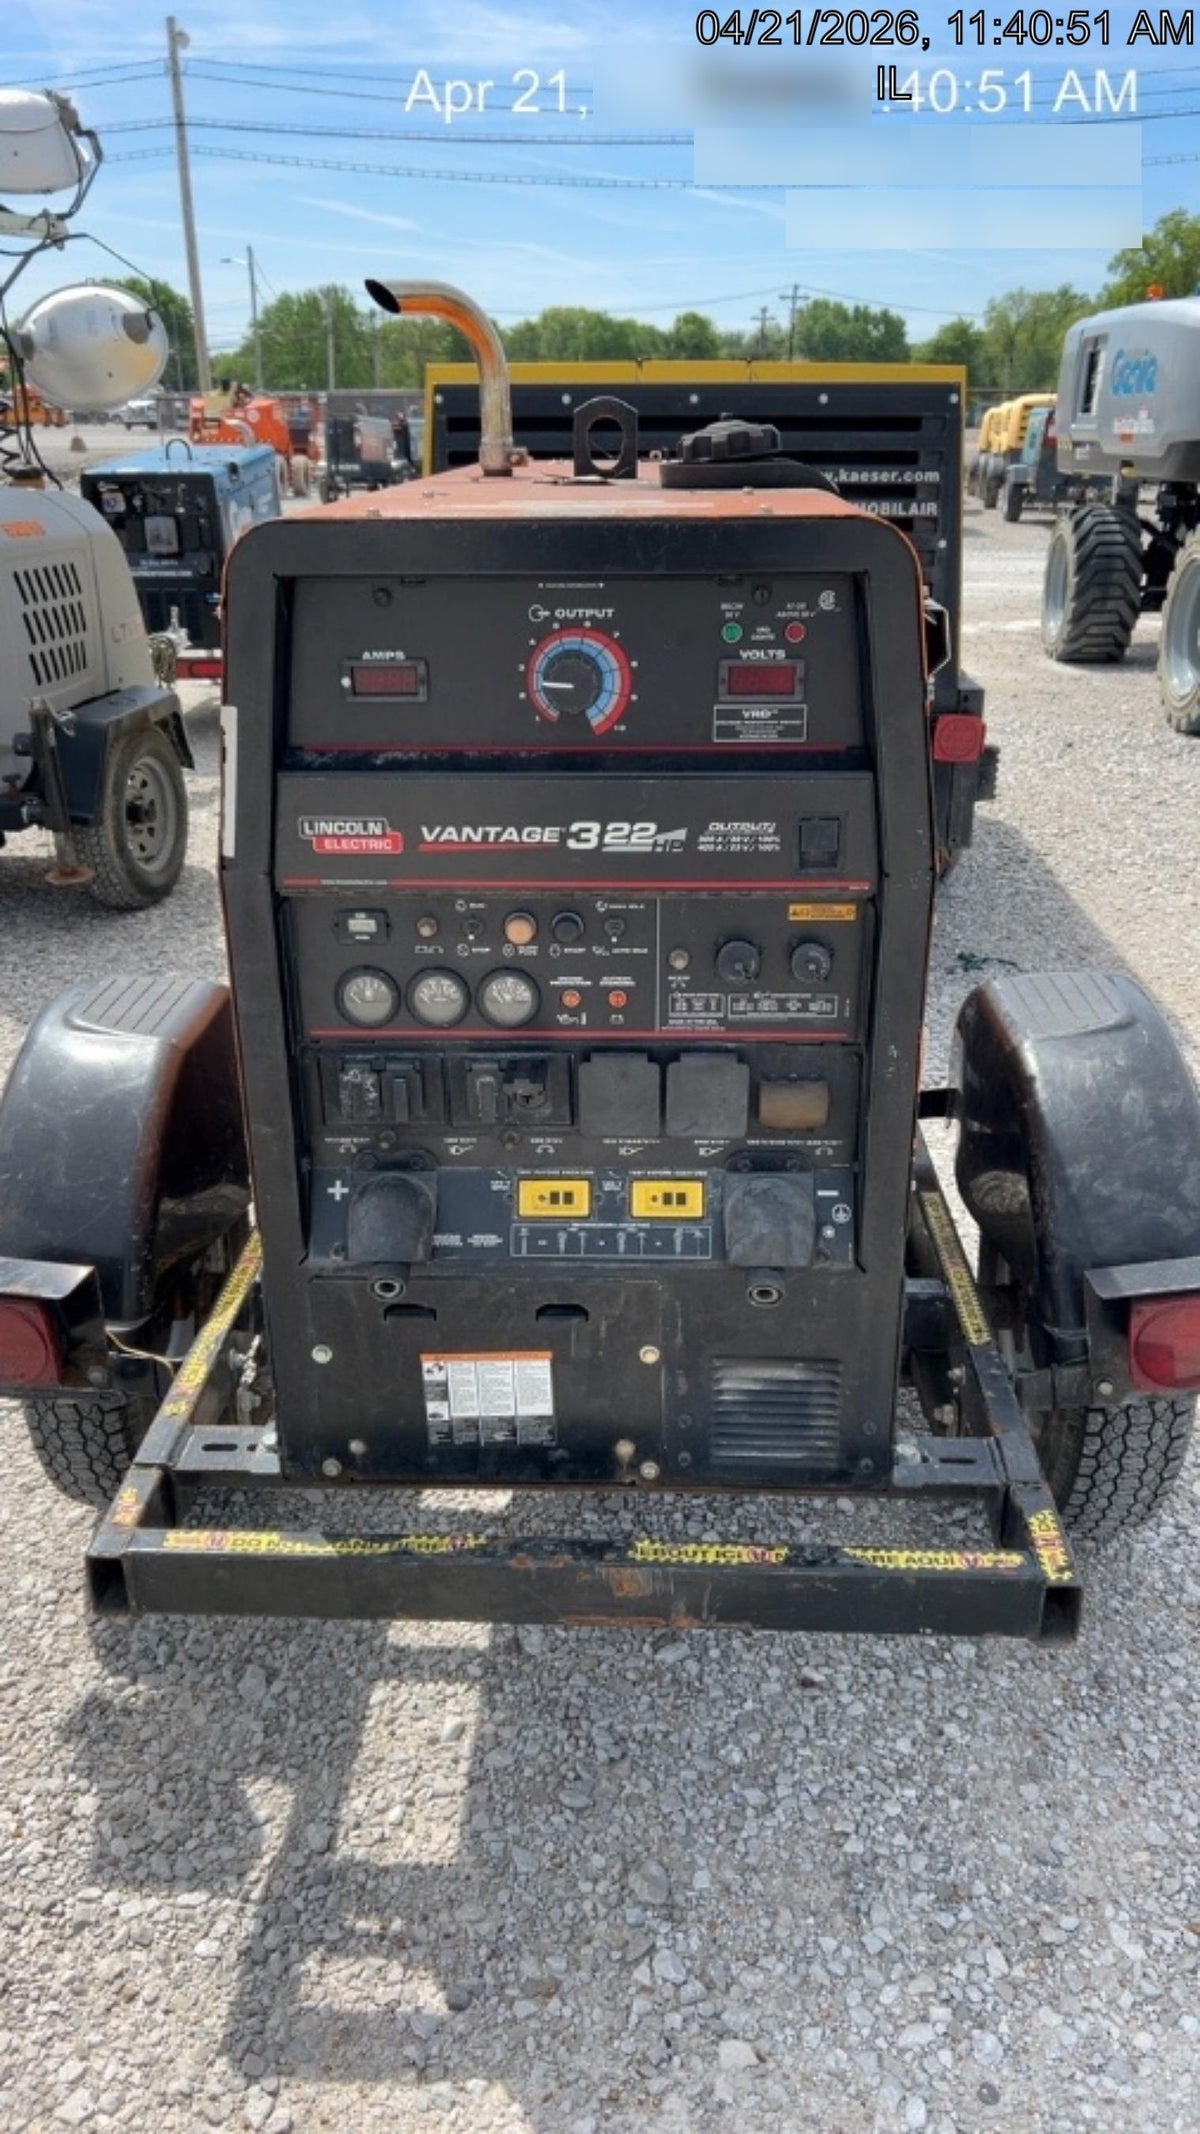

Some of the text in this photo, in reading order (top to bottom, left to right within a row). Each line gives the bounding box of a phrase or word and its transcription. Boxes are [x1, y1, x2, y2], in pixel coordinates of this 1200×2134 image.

[555, 608, 615, 618] OUTPUT
[362, 650, 406, 660] AMPS
[739, 649, 786, 660] VOLTS
[303, 821, 384, 836] LINCOLN
[420, 826, 562, 843] VANTAGE
[566, 822, 658, 849] 322
[323, 838, 393, 850] ELECTRIC
